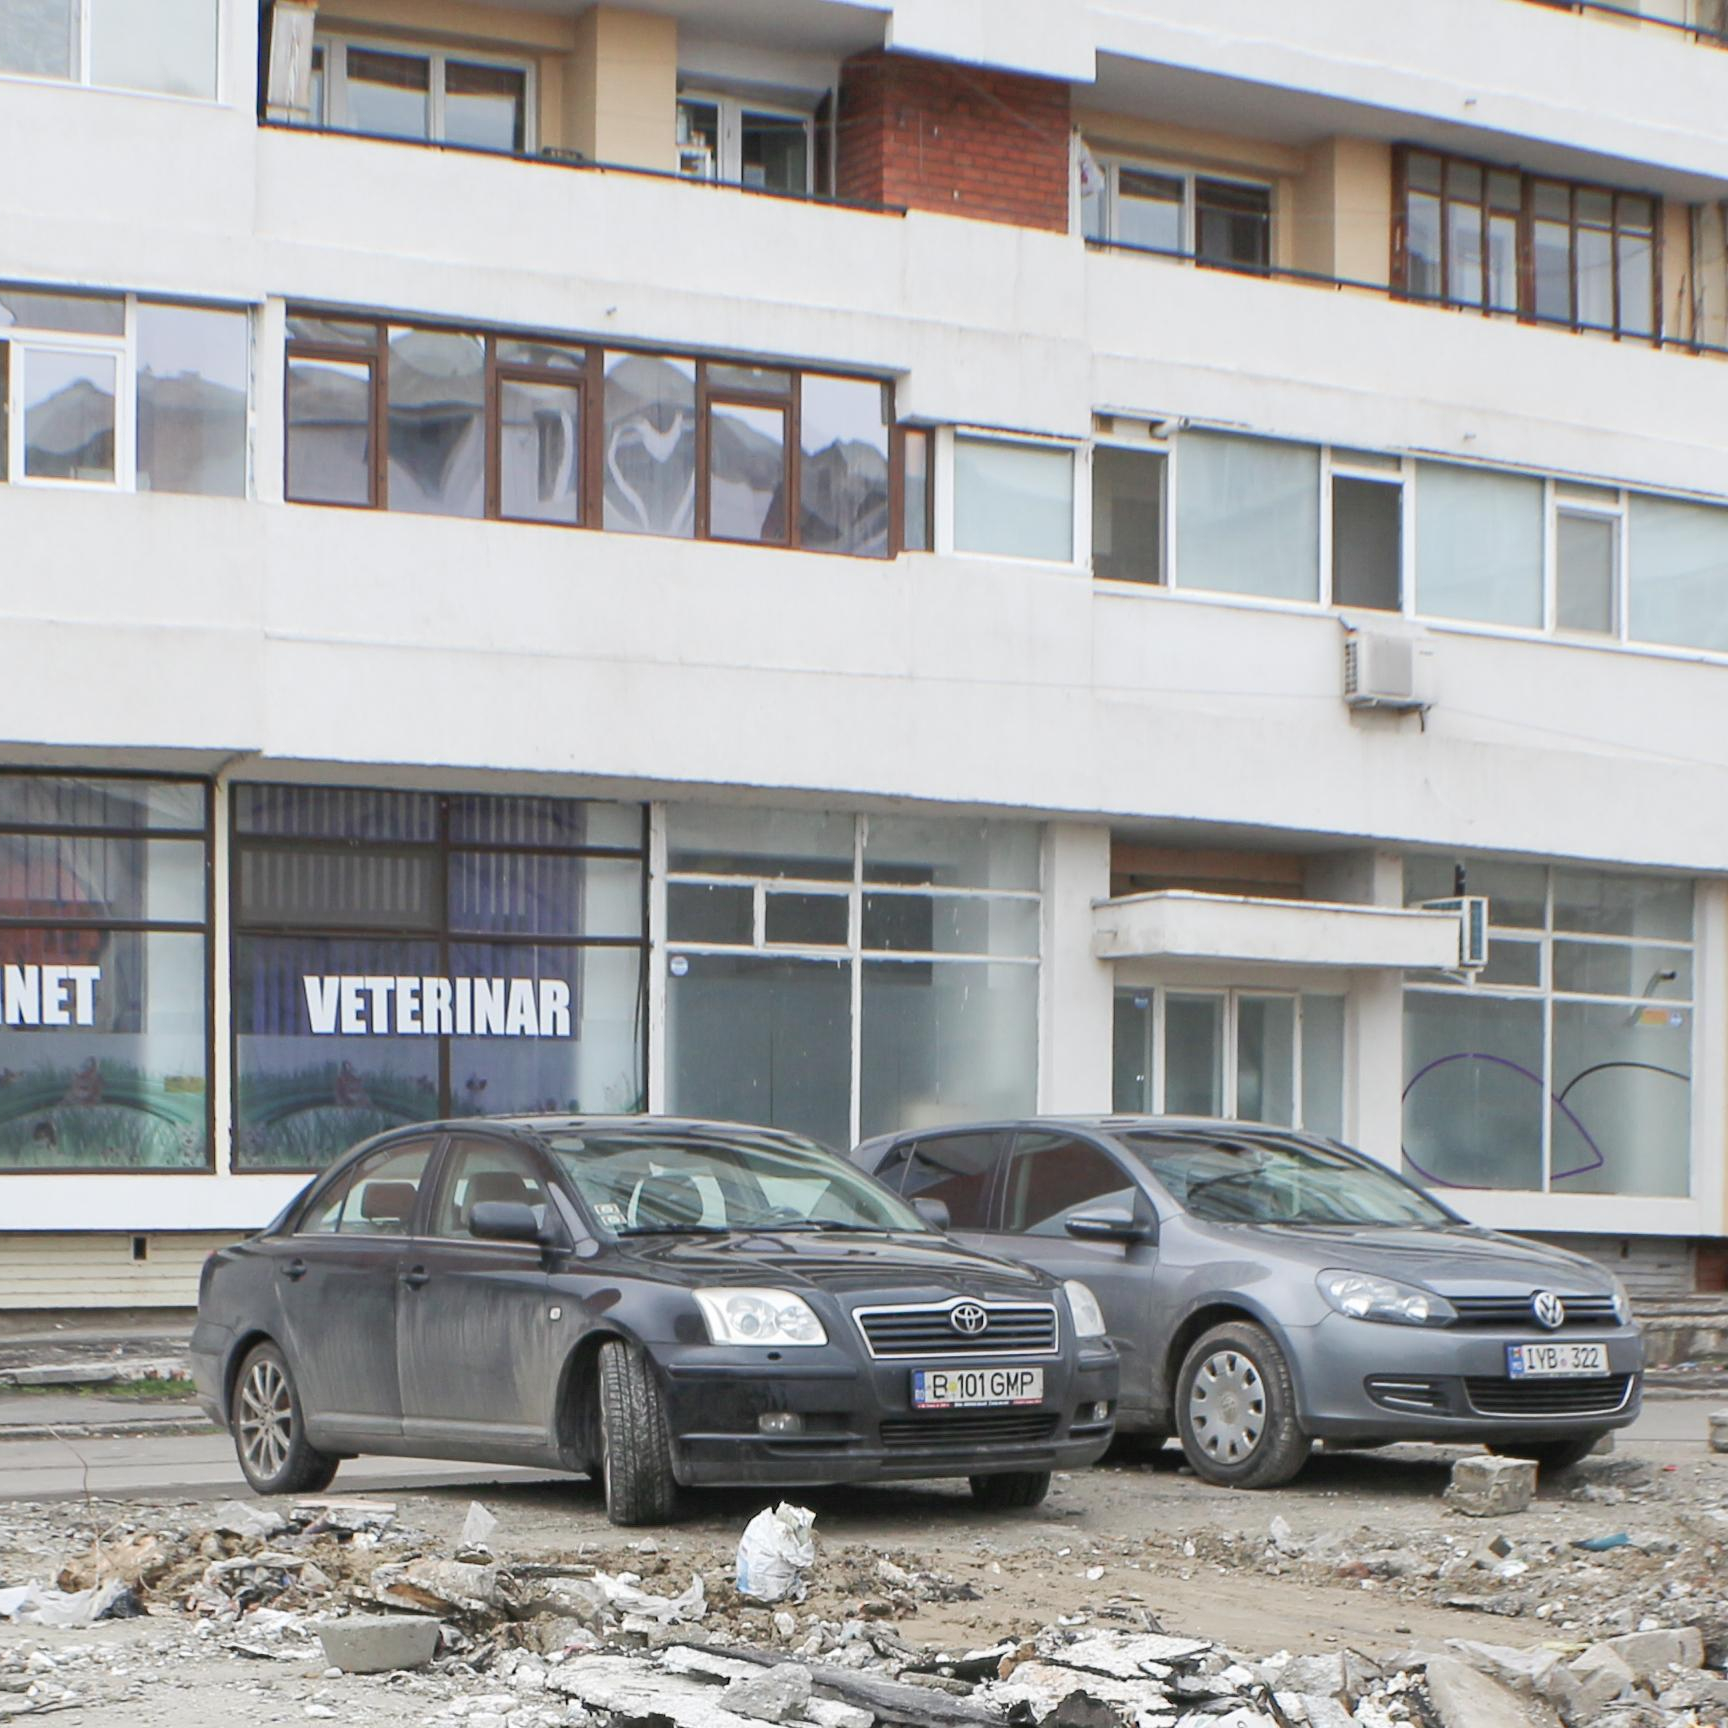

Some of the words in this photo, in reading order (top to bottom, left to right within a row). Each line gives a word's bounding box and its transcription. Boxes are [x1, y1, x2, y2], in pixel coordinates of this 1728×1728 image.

[303, 975, 571, 1037] VETERINAR
[1571, 1347, 1599, 1369] 322
[932, 1374, 948, 1399] B
[957, 1372, 985, 1399] 101
[990, 1371, 1034, 1397] GMP
